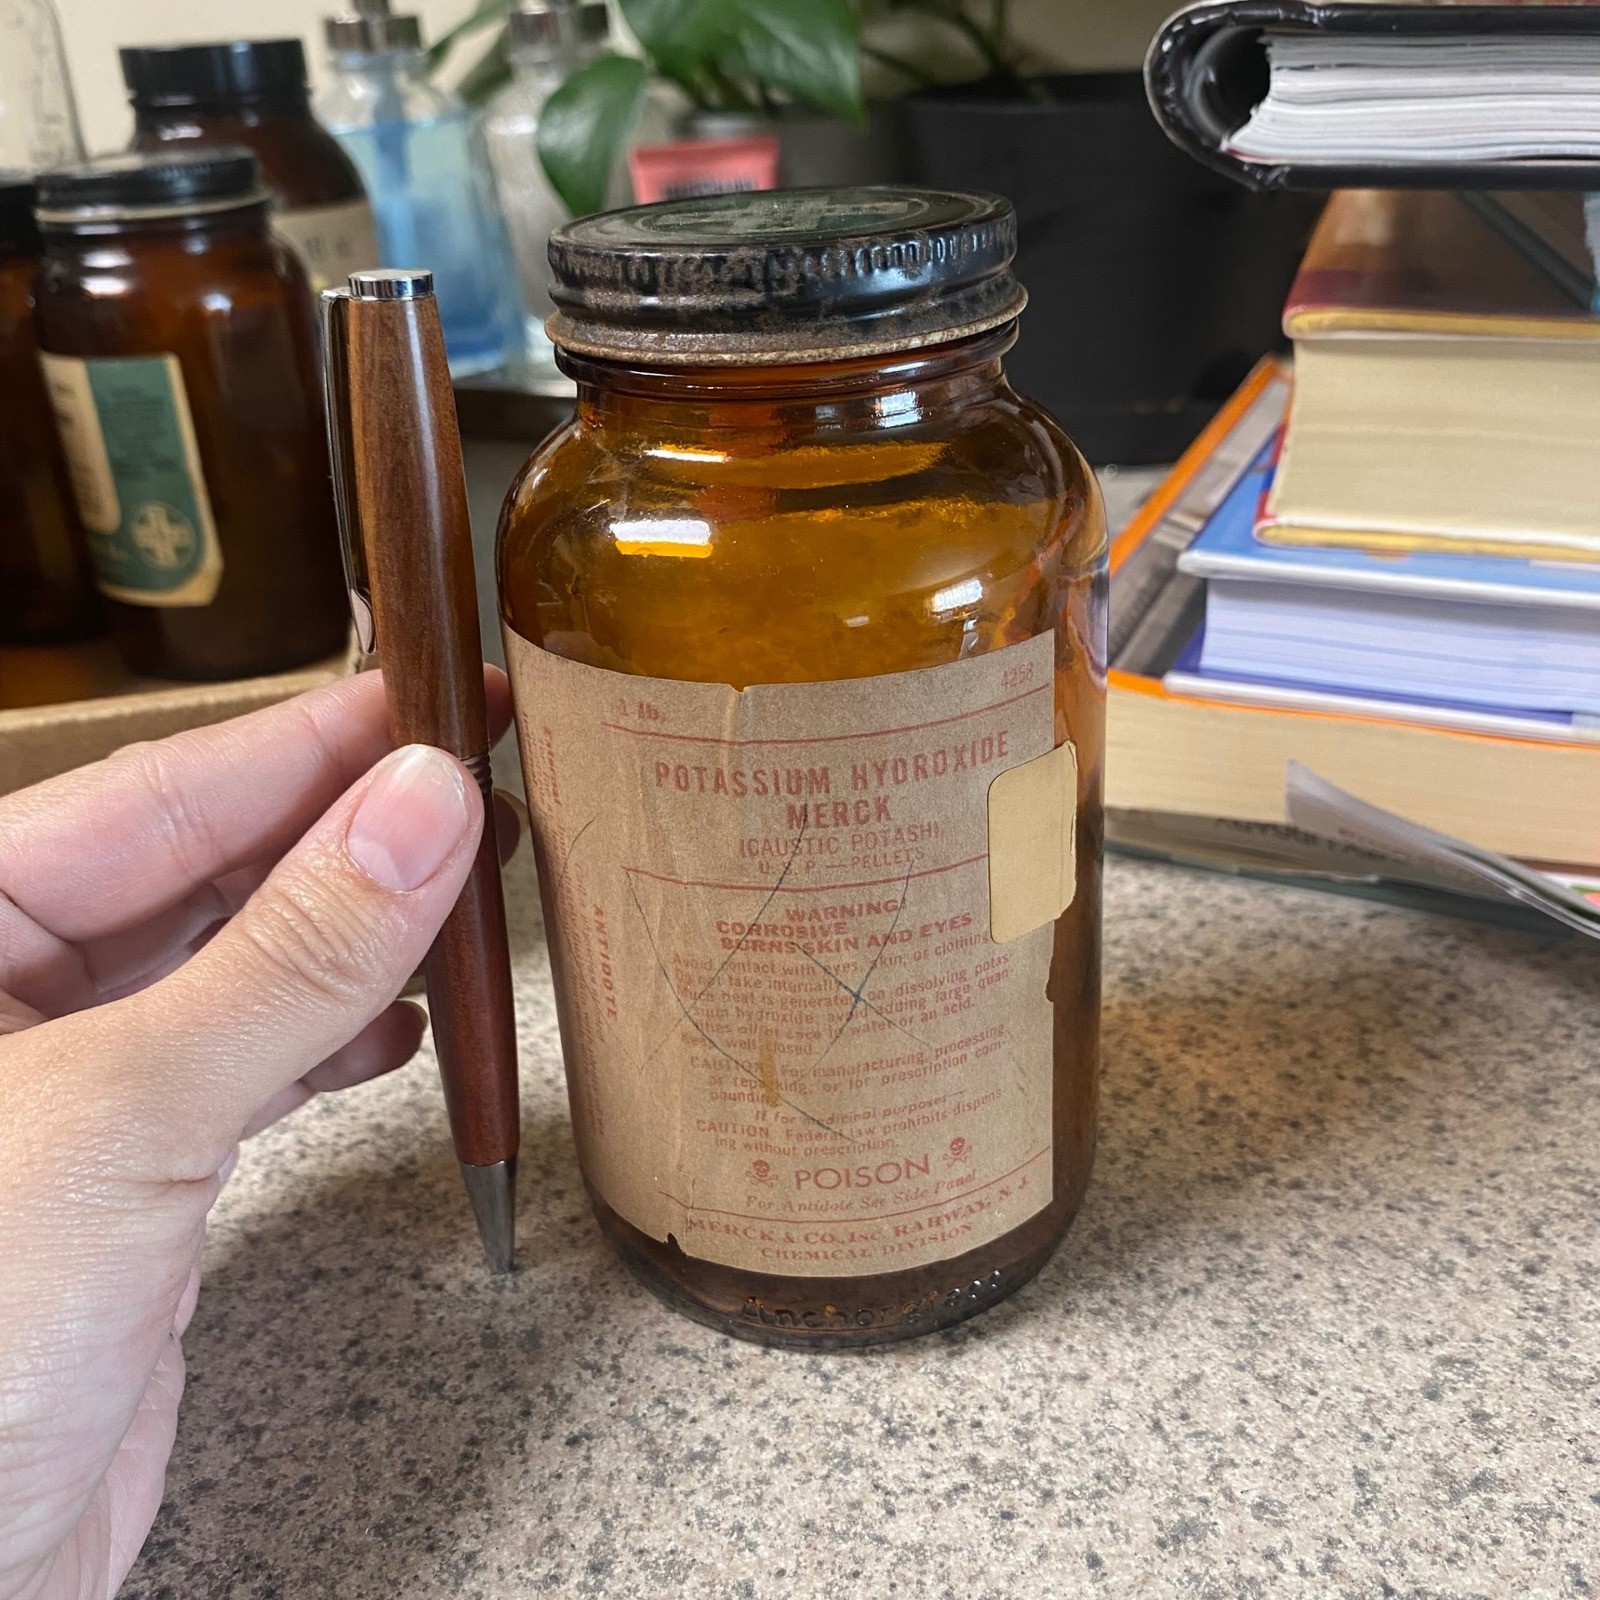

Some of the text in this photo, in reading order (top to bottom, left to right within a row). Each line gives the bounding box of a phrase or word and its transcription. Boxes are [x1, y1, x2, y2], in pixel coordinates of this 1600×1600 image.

[654, 731, 1009, 798] POTASSIUM HYDROXIDE
[786, 796, 893, 830] MERCK
[738, 821, 939, 859] (CAUSTIC POTASH)
[716, 920, 848, 937] CORROSIVE
[721, 912, 973, 953] BURNS SKIN AND EYES
[593, 904, 618, 1022] ANTIDOTE
[914, 950, 930, 961] or
[722, 990, 755, 1005] heat
[868, 990, 885, 1001] on
[895, 969, 968, 996] dissolving
[729, 975, 763, 988] take
[877, 997, 926, 1016] adding
[935, 983, 971, 1004] large
[737, 1024, 757, 1034] all
[851, 1015, 893, 1036] water
[899, 1014, 915, 1028] or
[920, 1008, 938, 1023] an
[727, 1038, 757, 1050] well
[708, 1075, 724, 1085] or
[733, 1076, 813, 1096] repaking,
[823, 1081, 840, 1094] or
[849, 1077, 869, 1090] for
[881, 1054, 968, 1087] prescription
[774, 1111, 796, 1124] for
[785, 1129, 843, 1143] Federal
[850, 1125, 876, 1139] law
[883, 1110, 948, 1136] prohibits
[715, 1137, 735, 1150] ing
[743, 1141, 797, 1156] without
[795, 1154, 931, 1191] POISON
[785, 1196, 851, 1213] Antidote
[860, 1193, 885, 1209] See
[893, 1184, 930, 1203] Side
[935, 1171, 979, 1193] Panel
[688, 1217, 773, 1243] MERCK
[782, 1229, 796, 1244] &
[760, 1222, 973, 1261] CHEMICAL DIVISION
